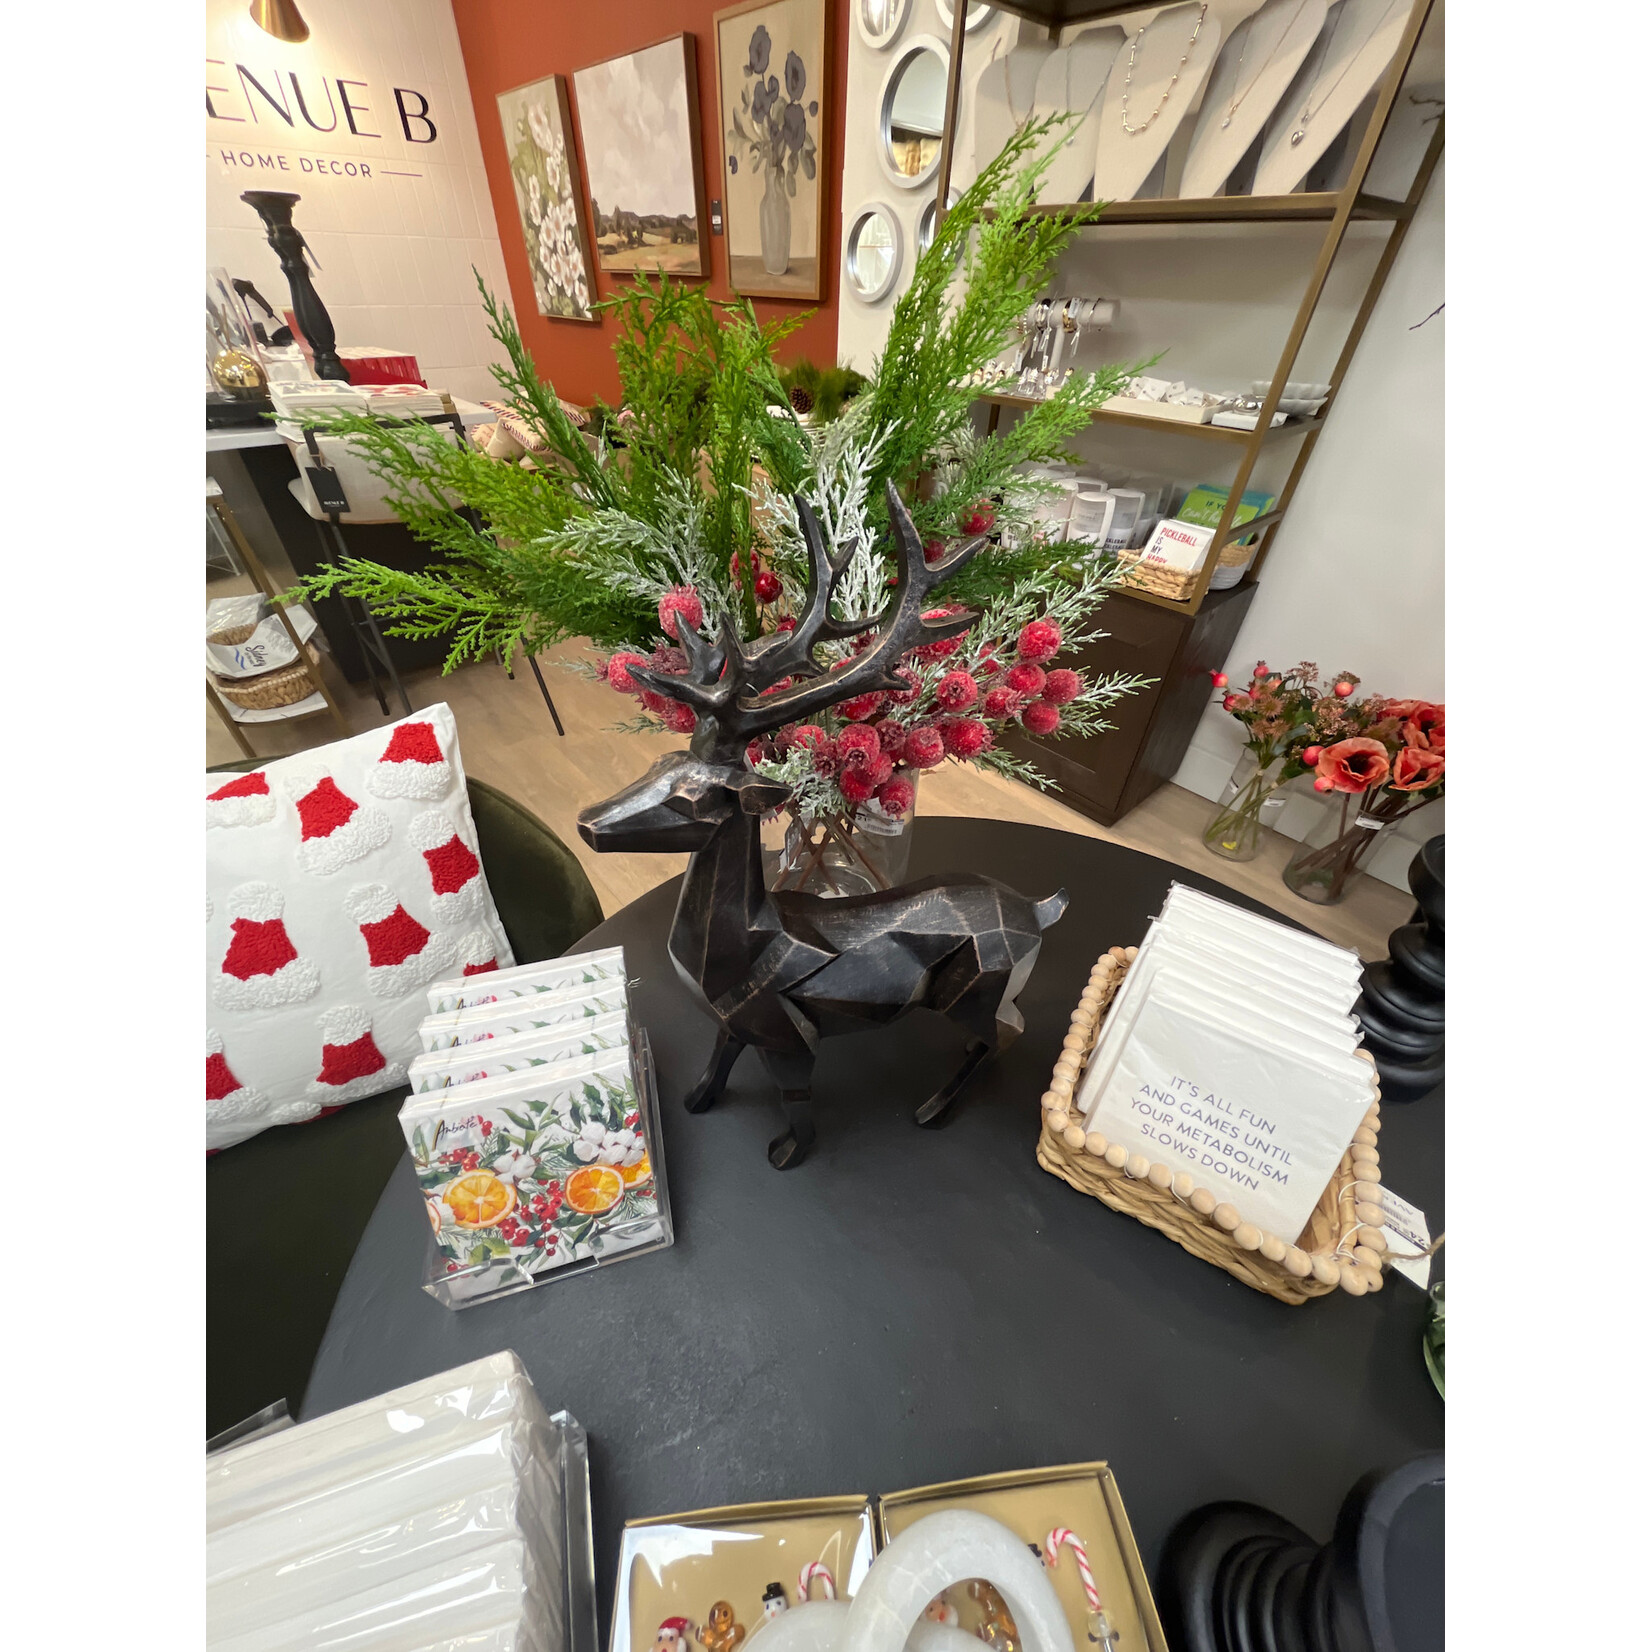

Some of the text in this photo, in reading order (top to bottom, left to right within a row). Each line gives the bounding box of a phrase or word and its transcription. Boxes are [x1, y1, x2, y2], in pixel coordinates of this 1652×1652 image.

[393, 87, 437, 144] B
[221, 150, 372, 178] HOME DECOR
[1217, 503, 1226, 511] YO
[1150, 545, 1163, 554] MY
[1155, 536, 1164, 545] IS
[1160, 527, 1198, 547] PICKLEBALL
[1139, 1084, 1293, 1166] AND GAMES UNTIL
[1171, 1075, 1276, 1135] IT'S ALL FUN
[1131, 1097, 1289, 1185] YOUR METABOLISM
[1141, 1123, 1259, 1191] SLOWS DOWN
